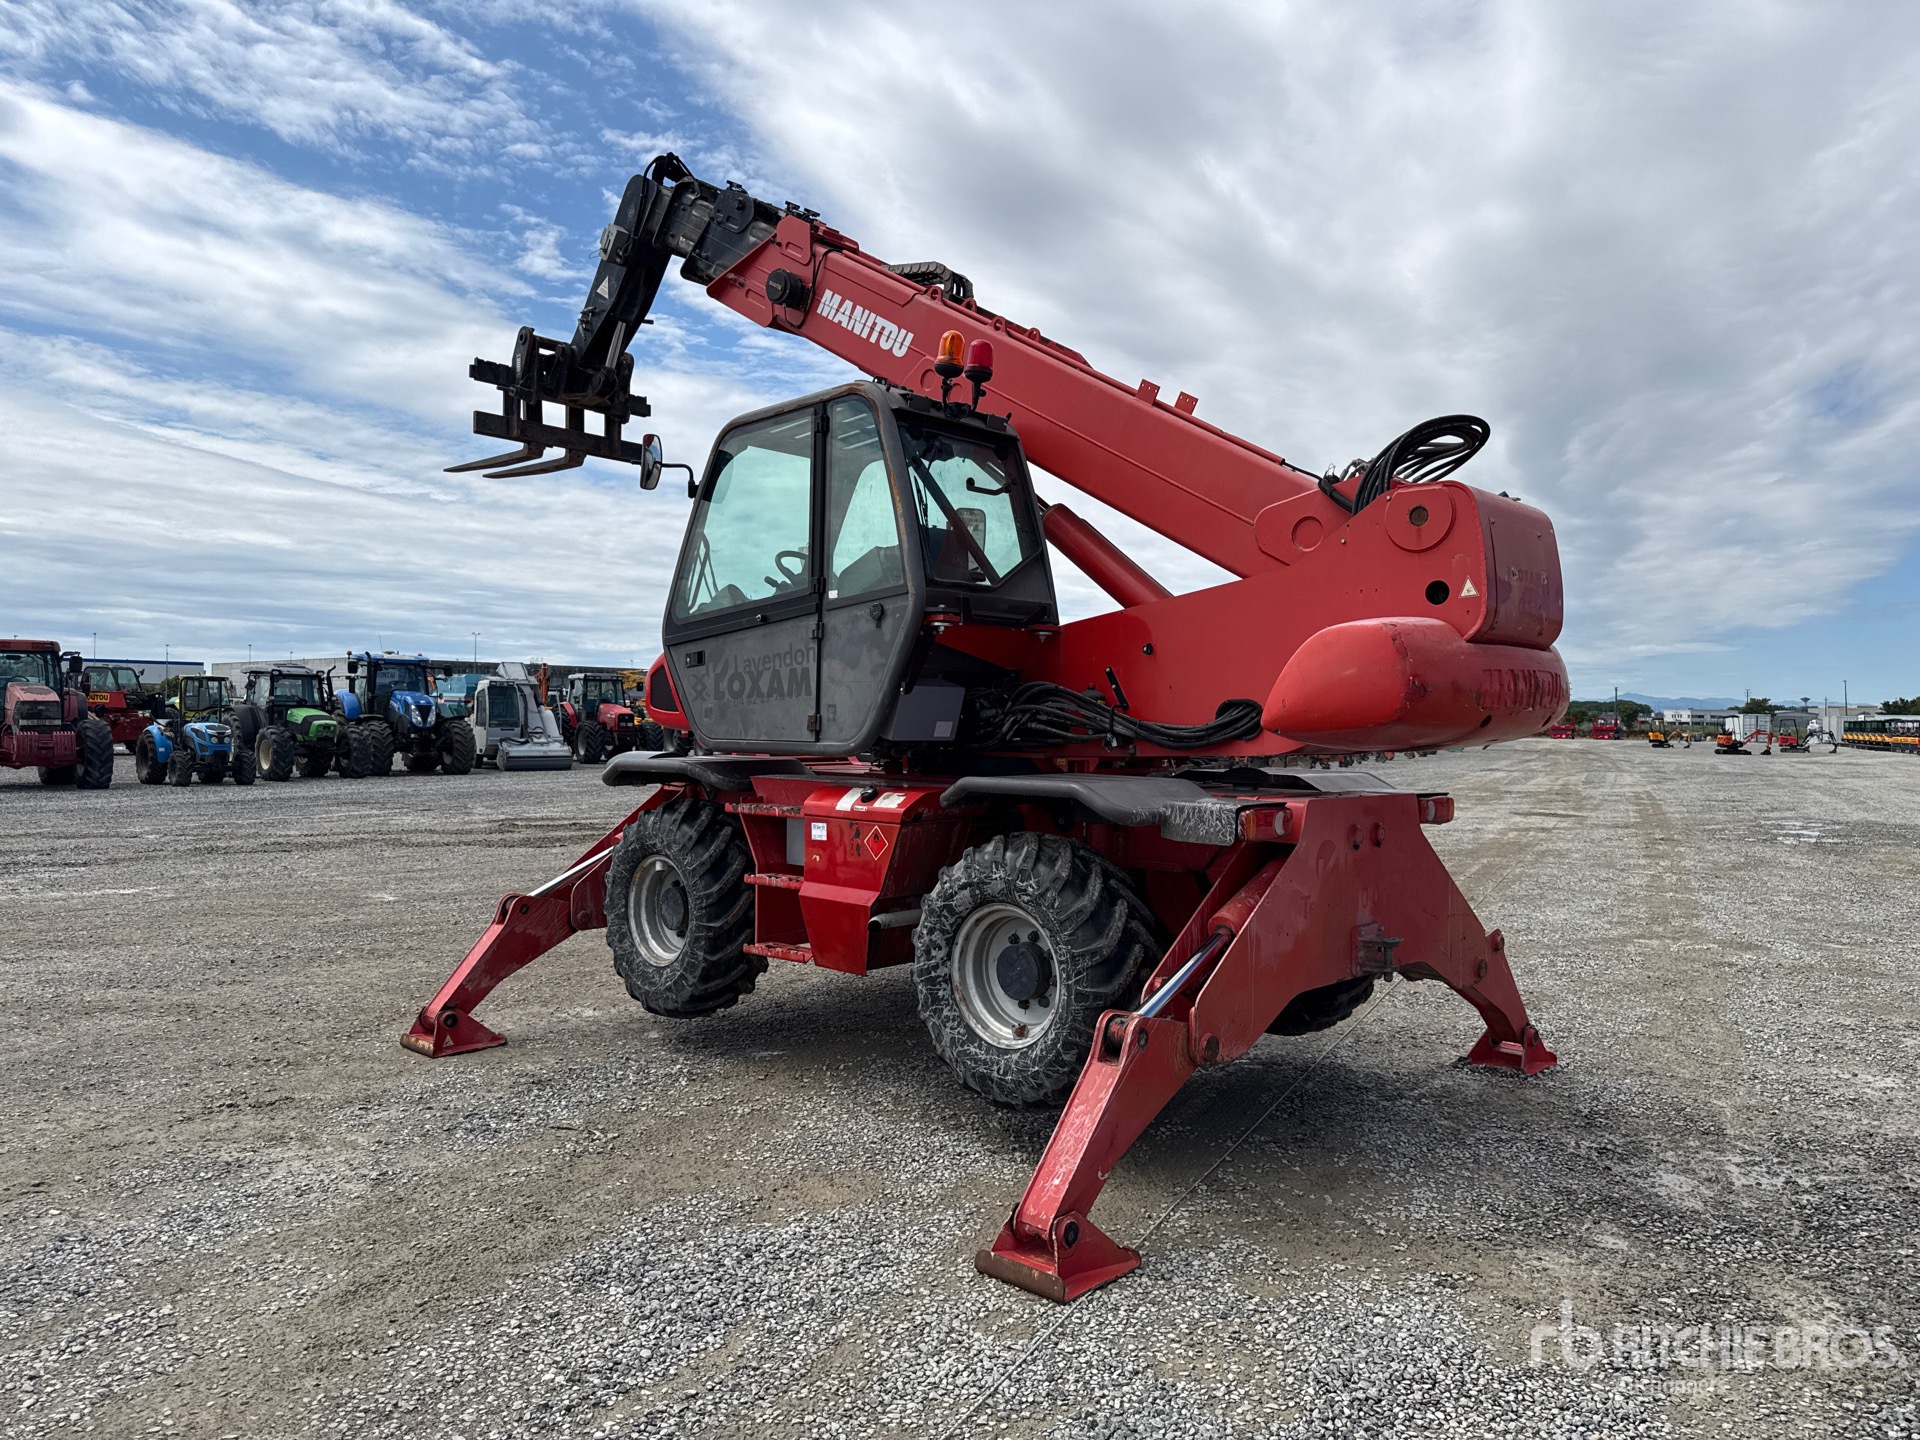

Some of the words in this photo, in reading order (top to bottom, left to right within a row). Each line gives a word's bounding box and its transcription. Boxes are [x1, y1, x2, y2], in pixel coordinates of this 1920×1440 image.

[816, 289, 914, 358] MANITOU
[735, 643, 816, 672] Lavendon
[714, 667, 812, 700] LOXAM
